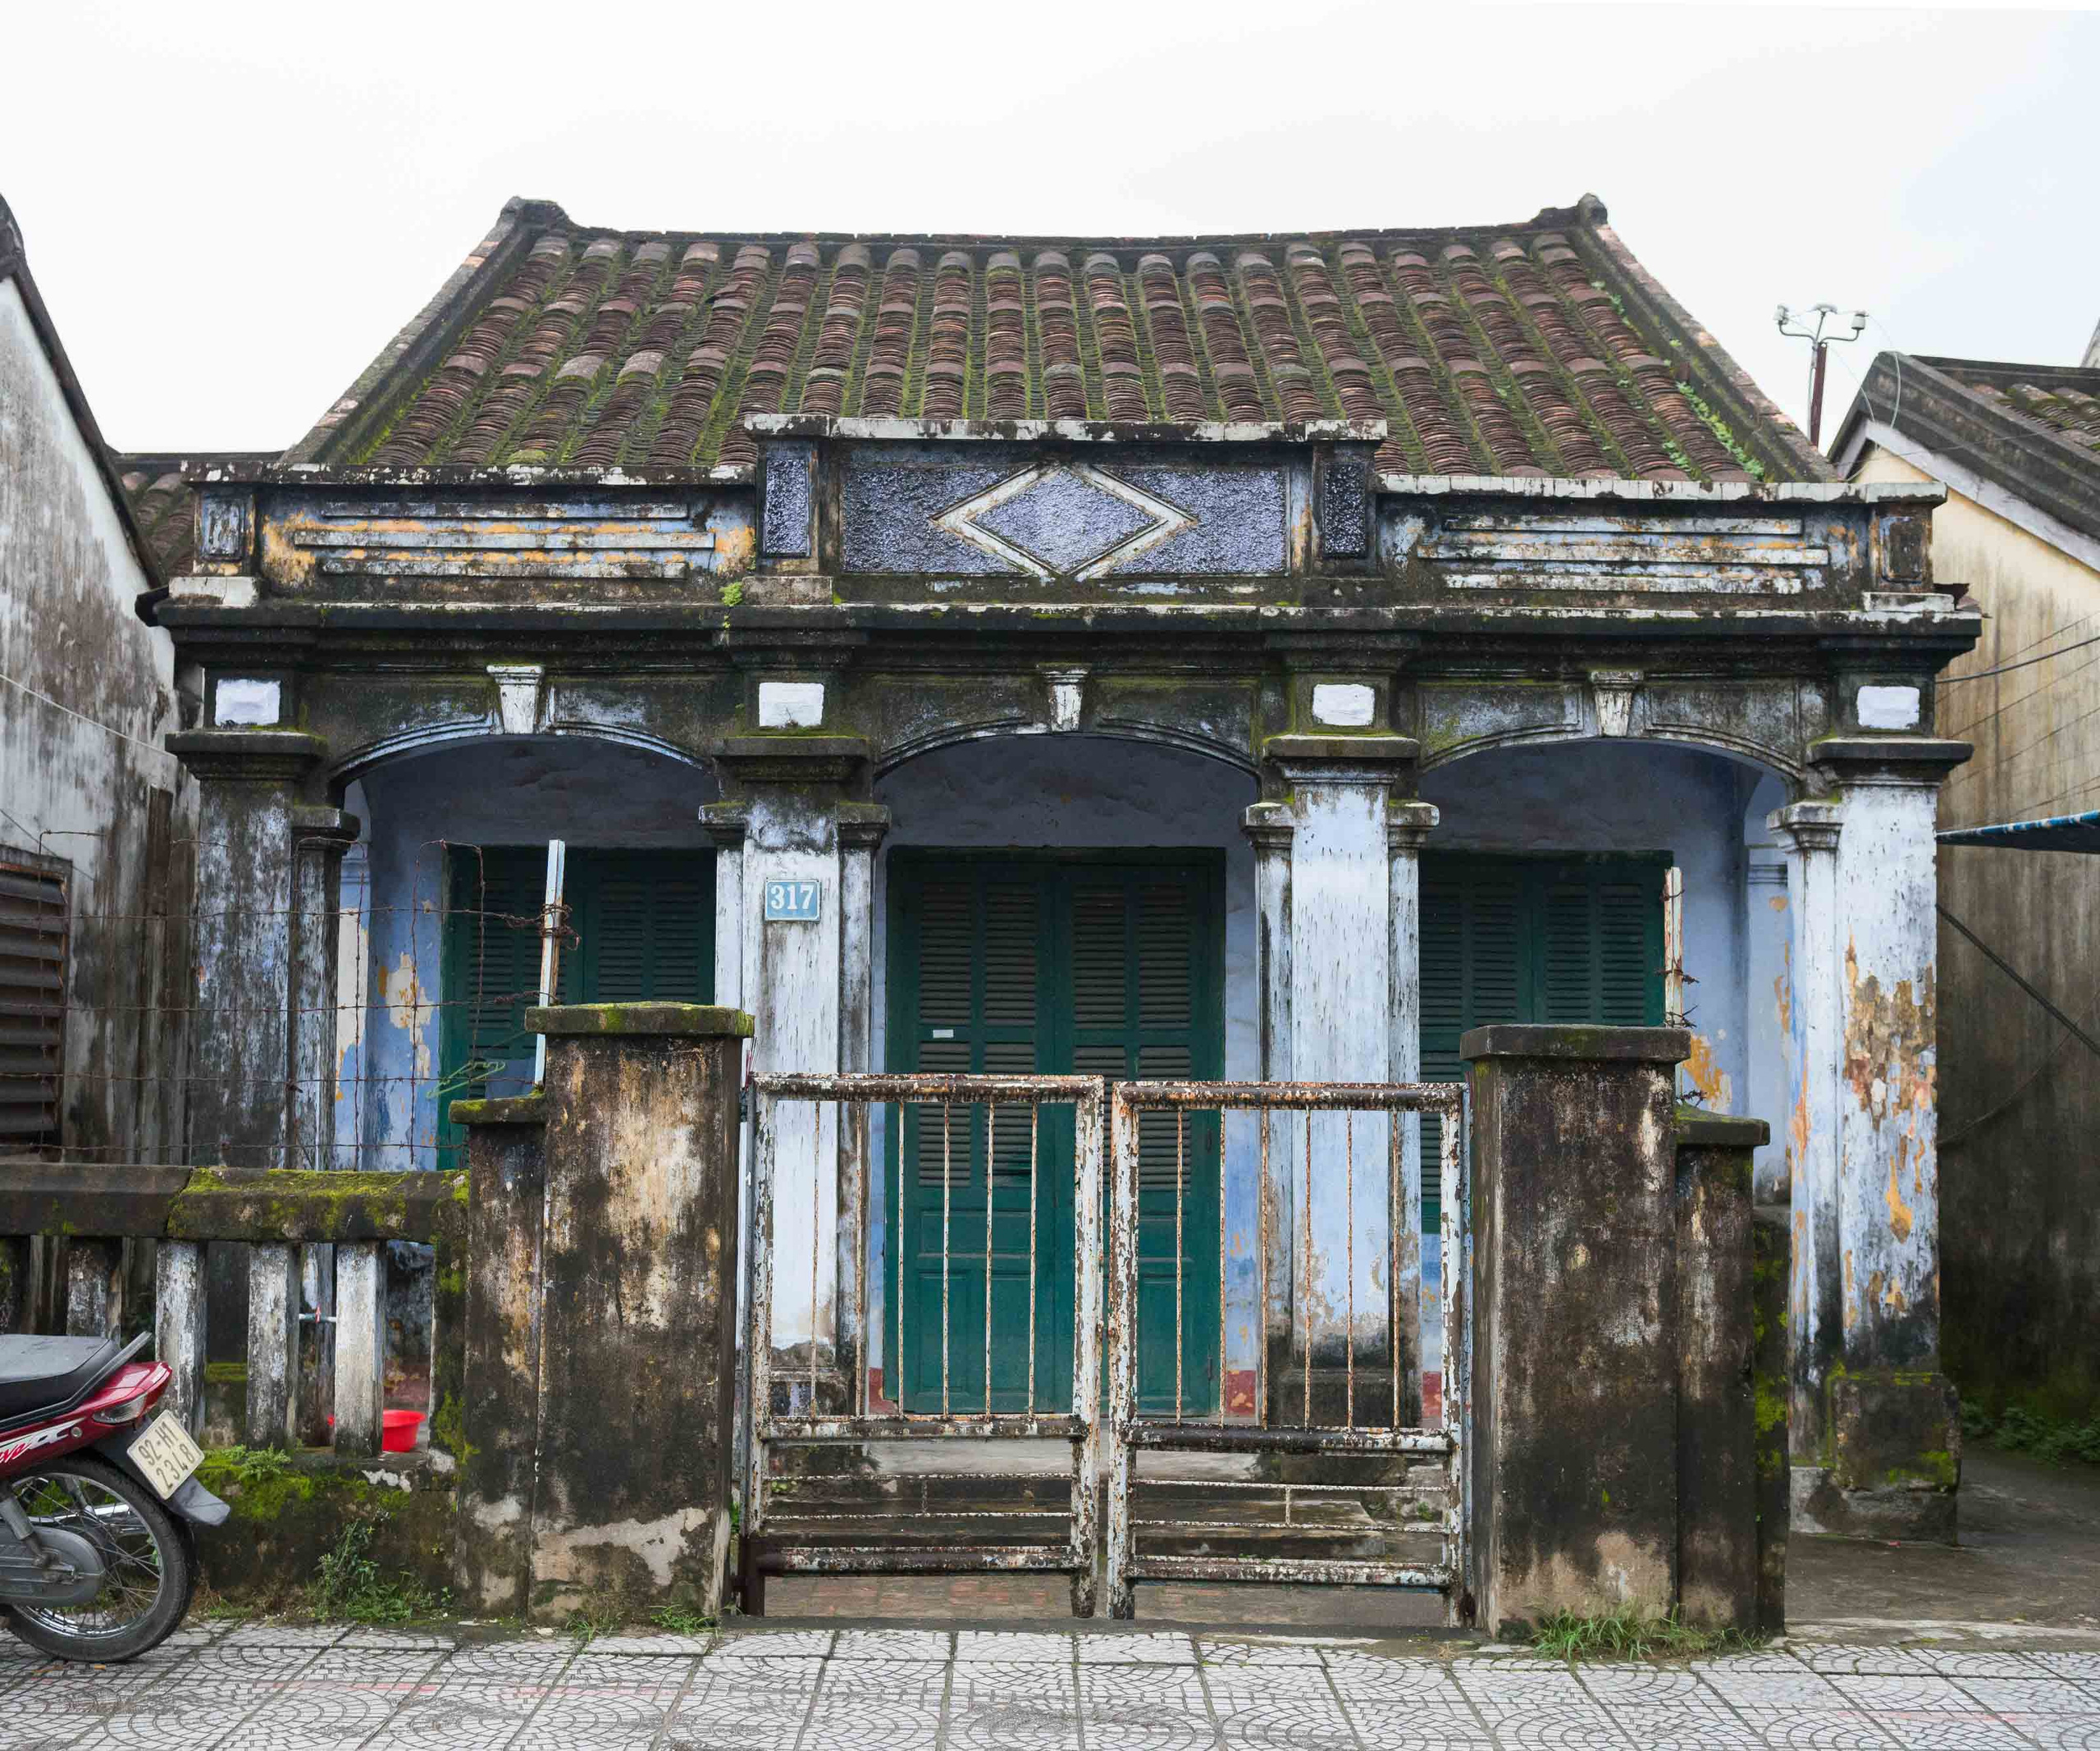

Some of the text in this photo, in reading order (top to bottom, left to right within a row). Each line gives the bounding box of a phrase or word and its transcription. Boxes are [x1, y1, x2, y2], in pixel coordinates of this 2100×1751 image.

[771, 885, 815, 910] 317
[138, 1421, 179, 1465] 92-H1
[156, 1443, 195, 1489] 2348
